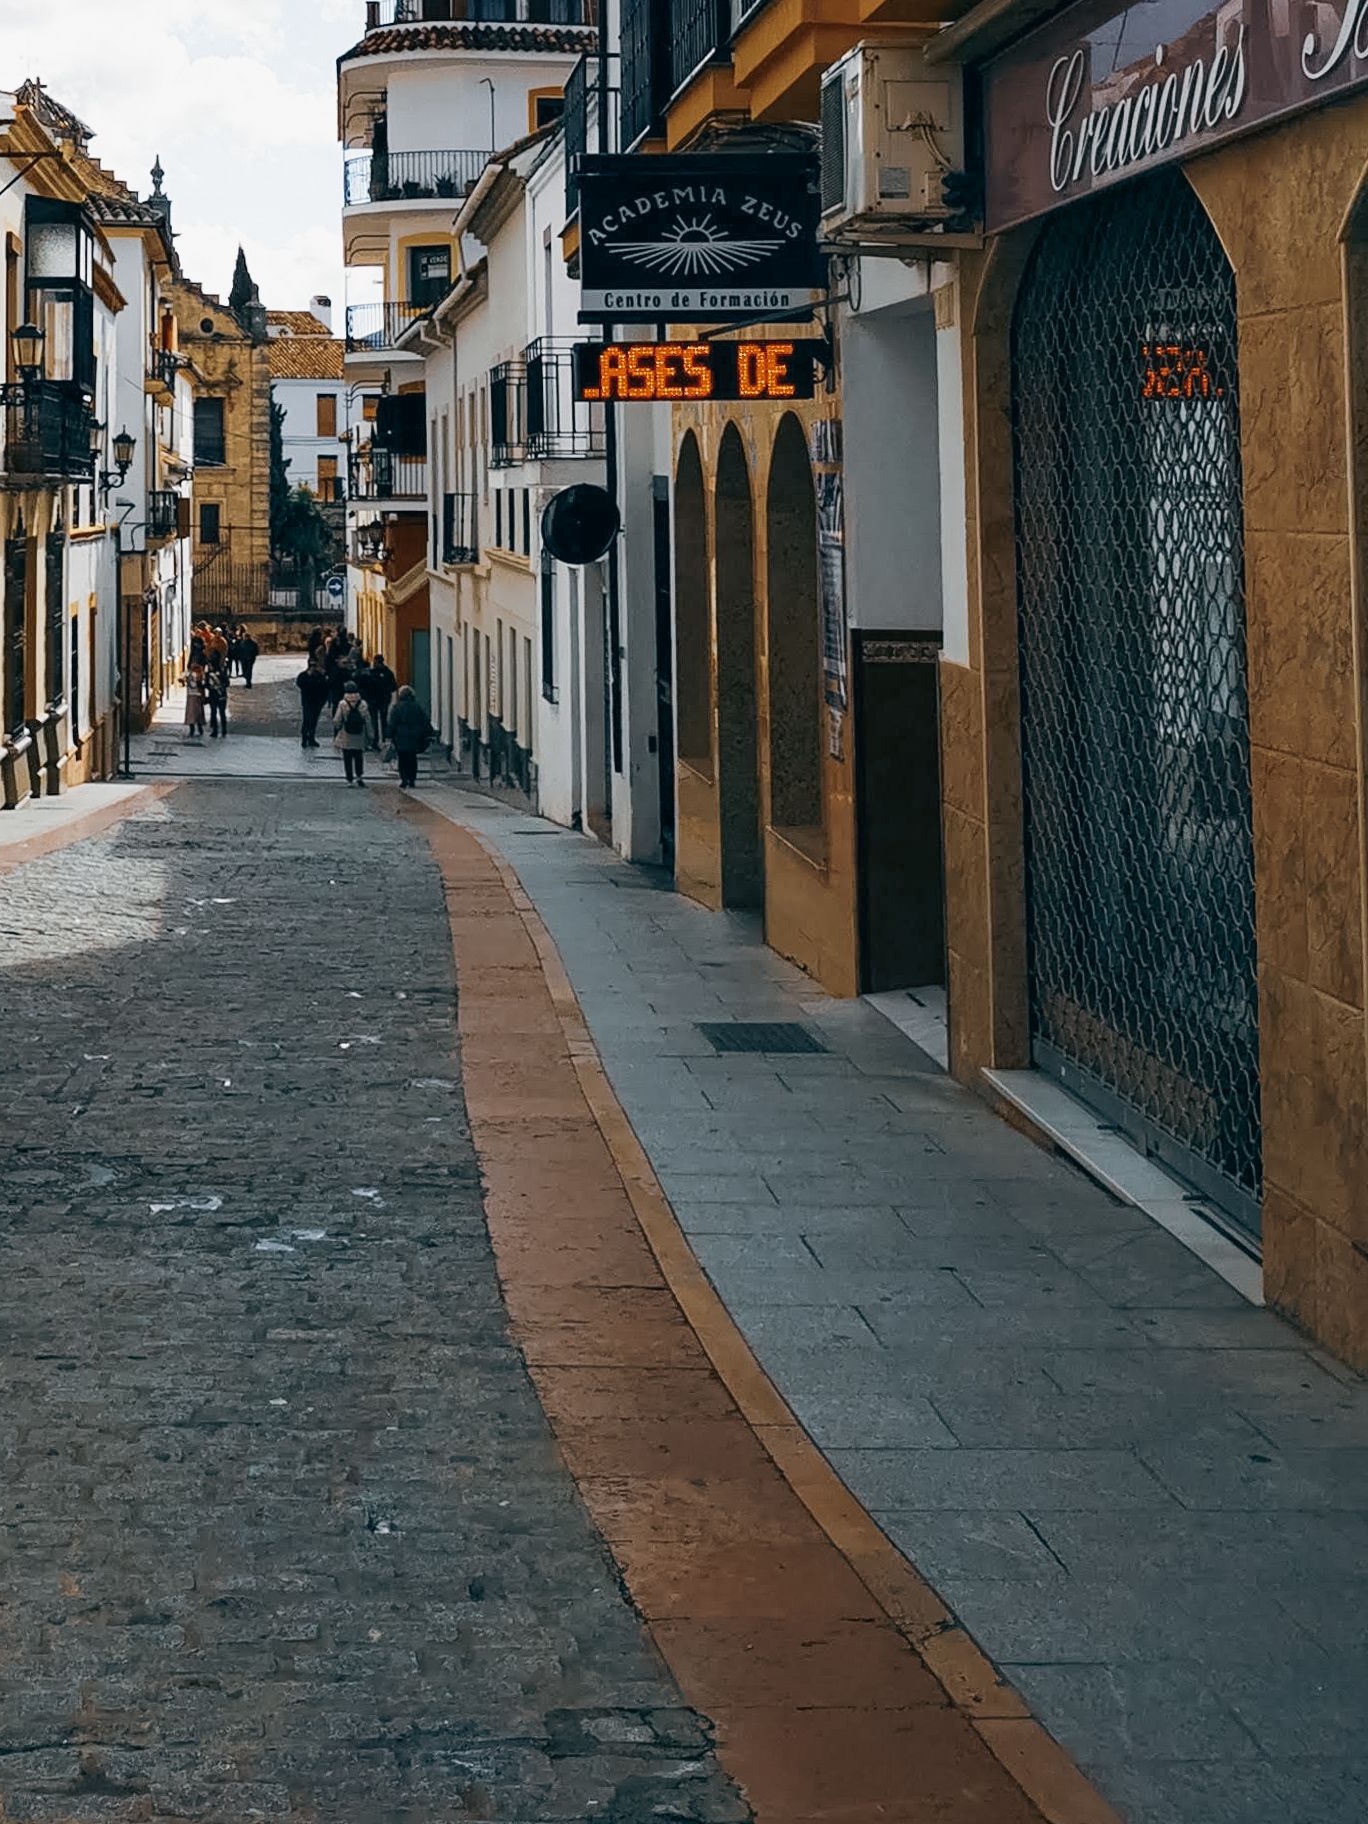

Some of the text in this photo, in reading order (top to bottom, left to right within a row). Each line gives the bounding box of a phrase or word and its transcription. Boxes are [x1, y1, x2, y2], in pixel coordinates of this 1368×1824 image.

[1046, 21, 1245, 192] Creaciones
[587, 185, 803, 246] ACADEMIA ZEUS
[604, 290, 790, 308] Centro de Formación
[583, 343, 795, 399] ASES DE
